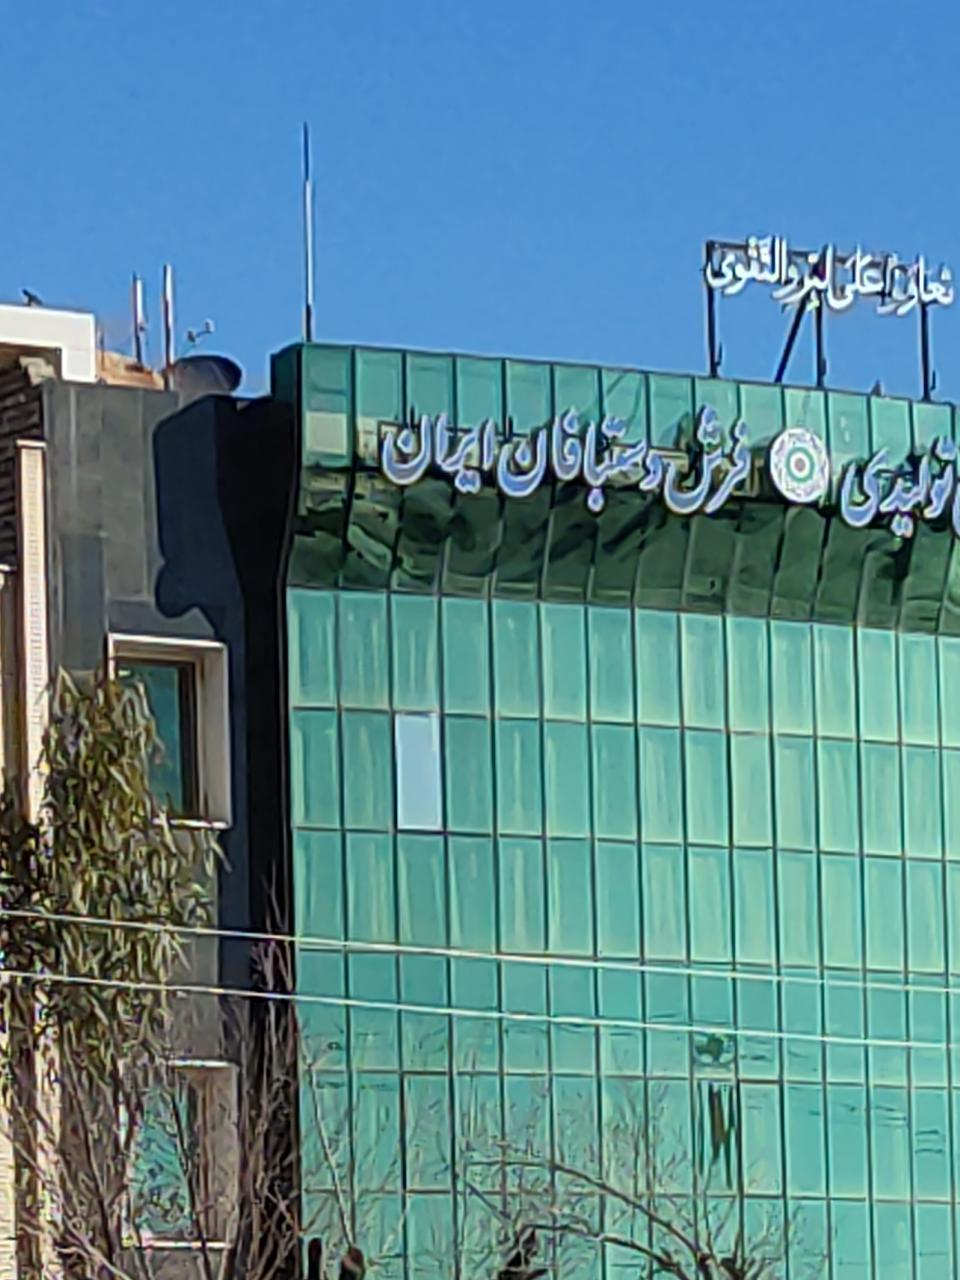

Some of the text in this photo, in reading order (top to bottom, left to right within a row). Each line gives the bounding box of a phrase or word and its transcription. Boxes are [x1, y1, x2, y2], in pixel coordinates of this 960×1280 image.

[382, 412, 495, 494] ایران
[500, 406, 663, 513] دستبافان
[663, 403, 751, 515] فرش
[840, 435, 957, 539] تولیدی
